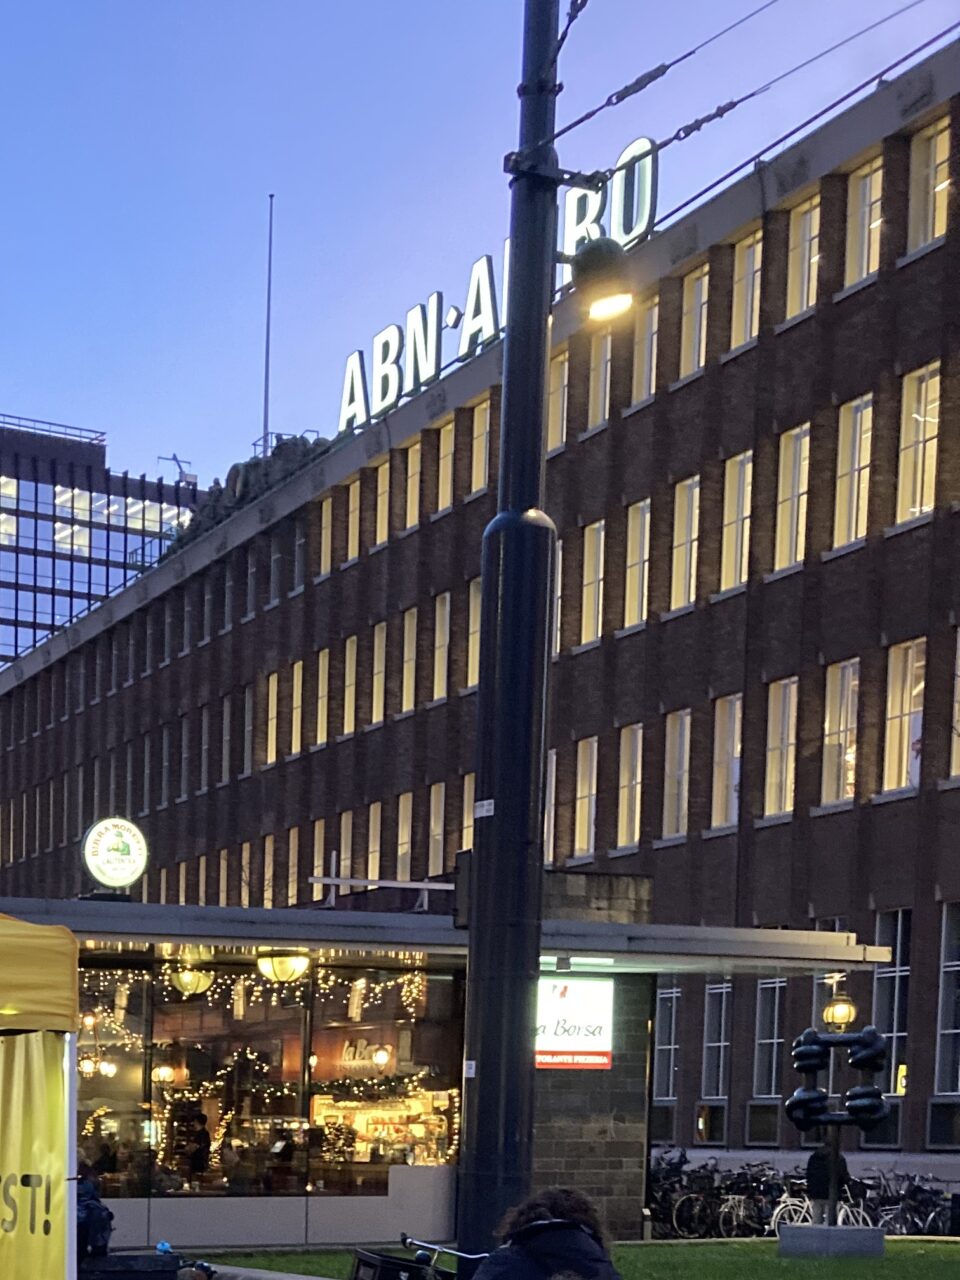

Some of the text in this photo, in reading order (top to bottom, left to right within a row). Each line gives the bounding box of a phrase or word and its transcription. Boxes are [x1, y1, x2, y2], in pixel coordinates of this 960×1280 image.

[338, 136, 658, 433] ABN·ARO
[91, 826, 111, 857] BIRRA
[553, 1018, 603, 1037] Borsa
